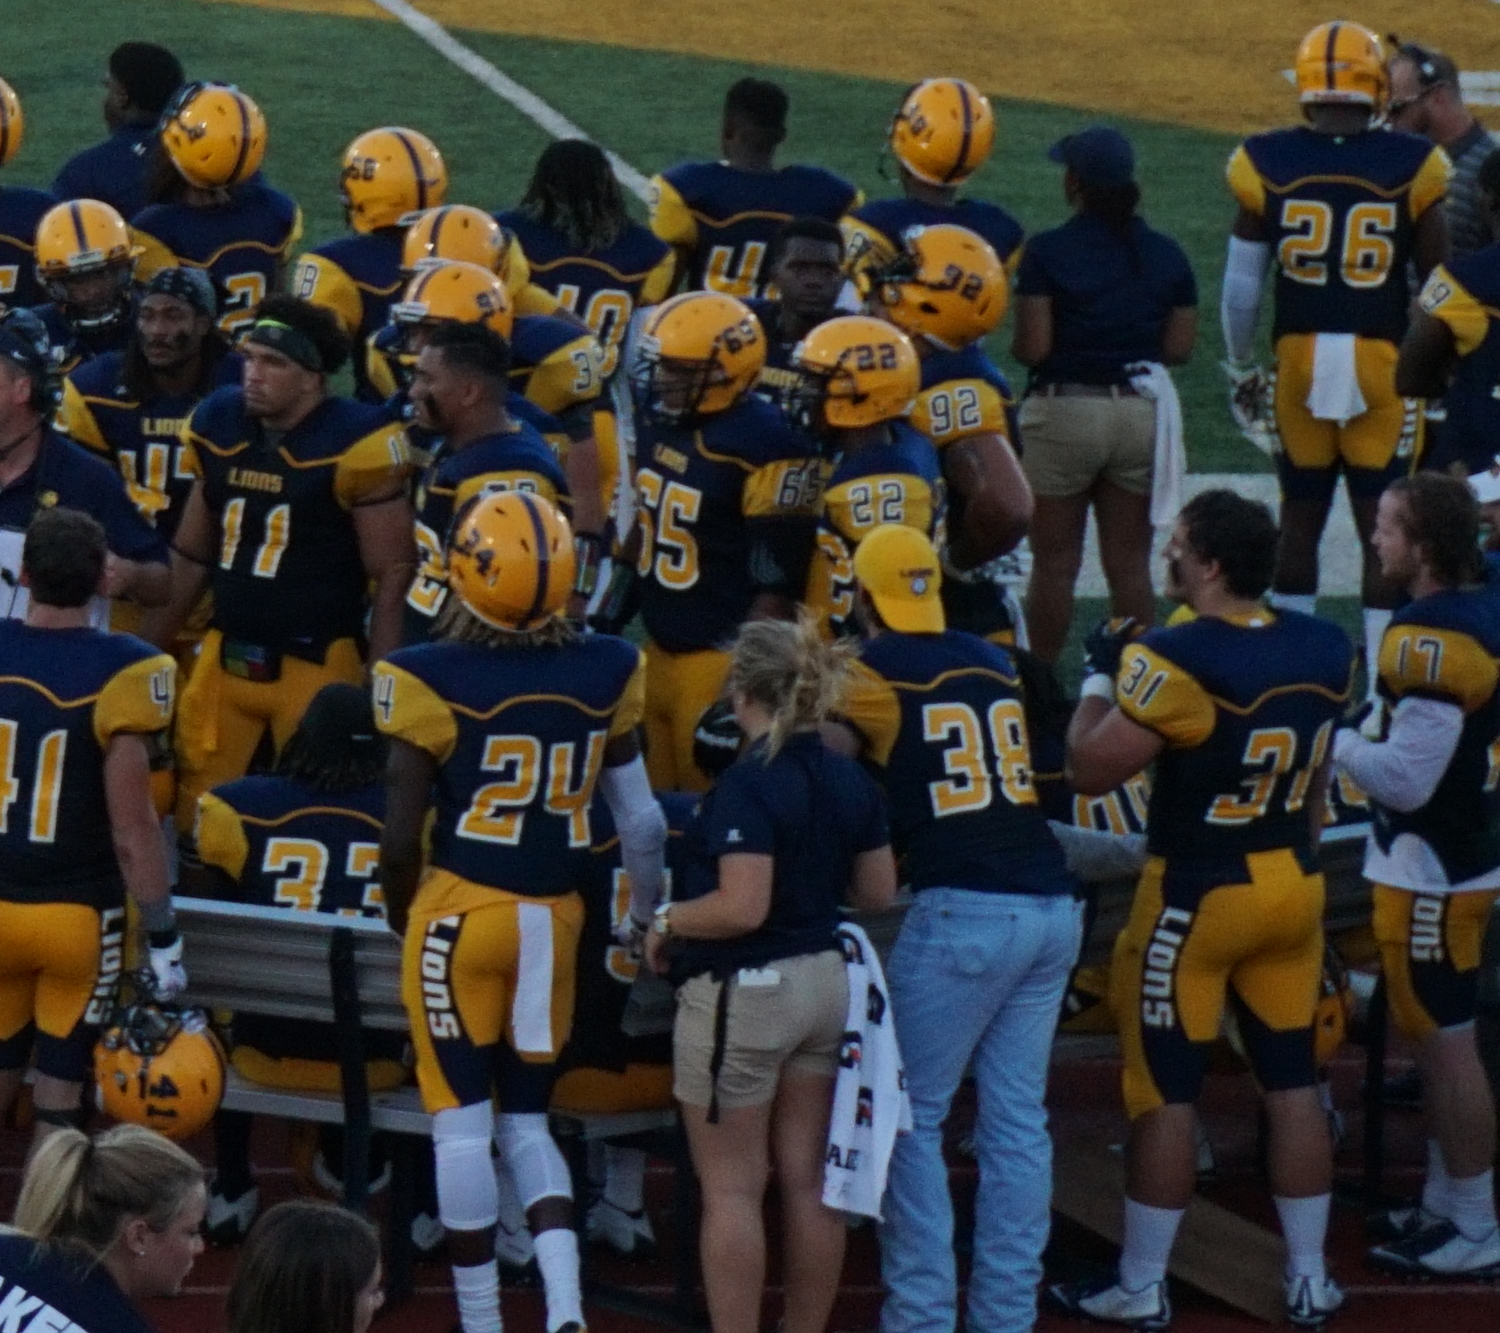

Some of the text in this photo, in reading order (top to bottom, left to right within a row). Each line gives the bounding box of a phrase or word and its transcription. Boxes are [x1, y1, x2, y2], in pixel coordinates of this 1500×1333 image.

[1276, 199, 1398, 289] 26
[856, 341, 896, 371] 22
[930, 387, 981, 437] 92
[228, 465, 284, 493] LIONS
[851, 481, 906, 527] 22
[219, 497, 291, 579] 11
[1119, 655, 1168, 711] 31
[1397, 633, 1444, 685] 17
[455, 729, 610, 851] 24
[419, 913, 462, 1040] LIONS
[1140, 904, 1194, 1030] LIONS
